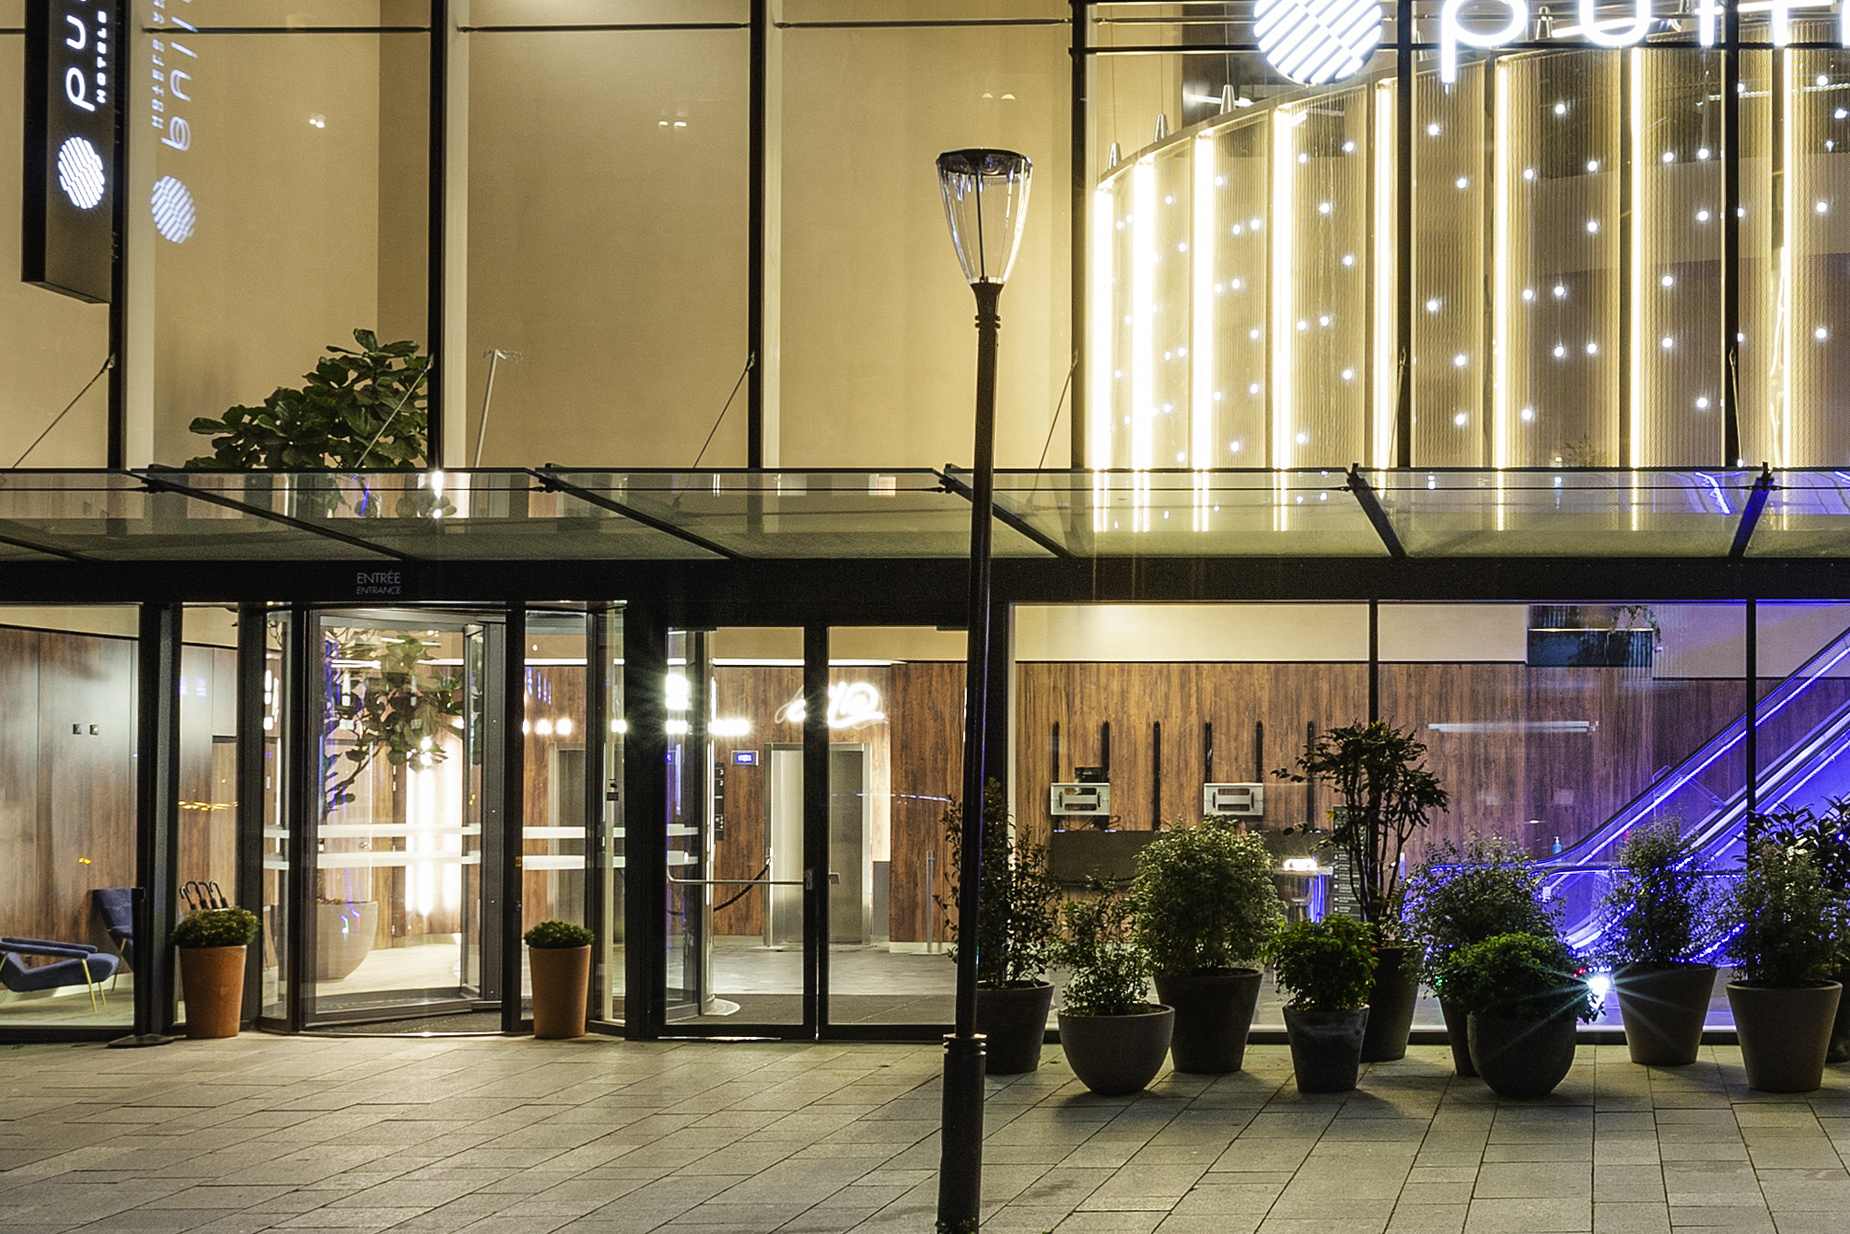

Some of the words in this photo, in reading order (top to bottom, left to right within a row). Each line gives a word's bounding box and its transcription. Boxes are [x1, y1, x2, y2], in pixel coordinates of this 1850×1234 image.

[96, 10, 107, 104] HOTELS
[357, 570, 401, 584] ENTRÉE
[356, 585, 401, 595] ENTRANCE
